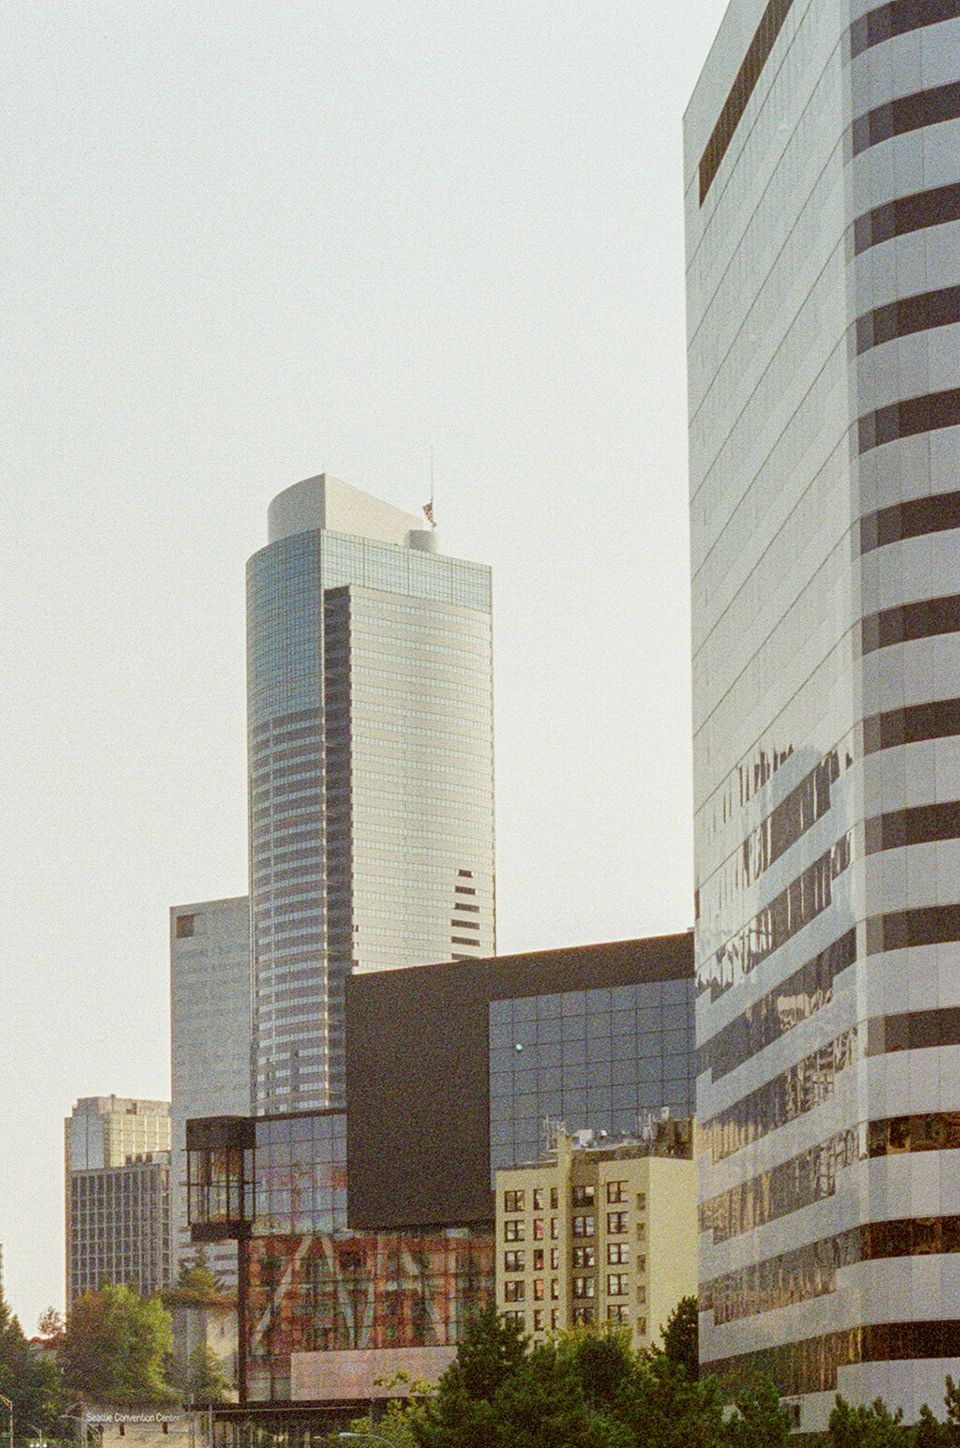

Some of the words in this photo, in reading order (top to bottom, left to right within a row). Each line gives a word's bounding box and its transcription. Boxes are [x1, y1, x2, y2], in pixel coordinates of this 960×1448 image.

[86, 1412, 113, 1422] Seattle
[114, 1412, 155, 1422] Convention
[156, 1412, 180, 1422] Center
